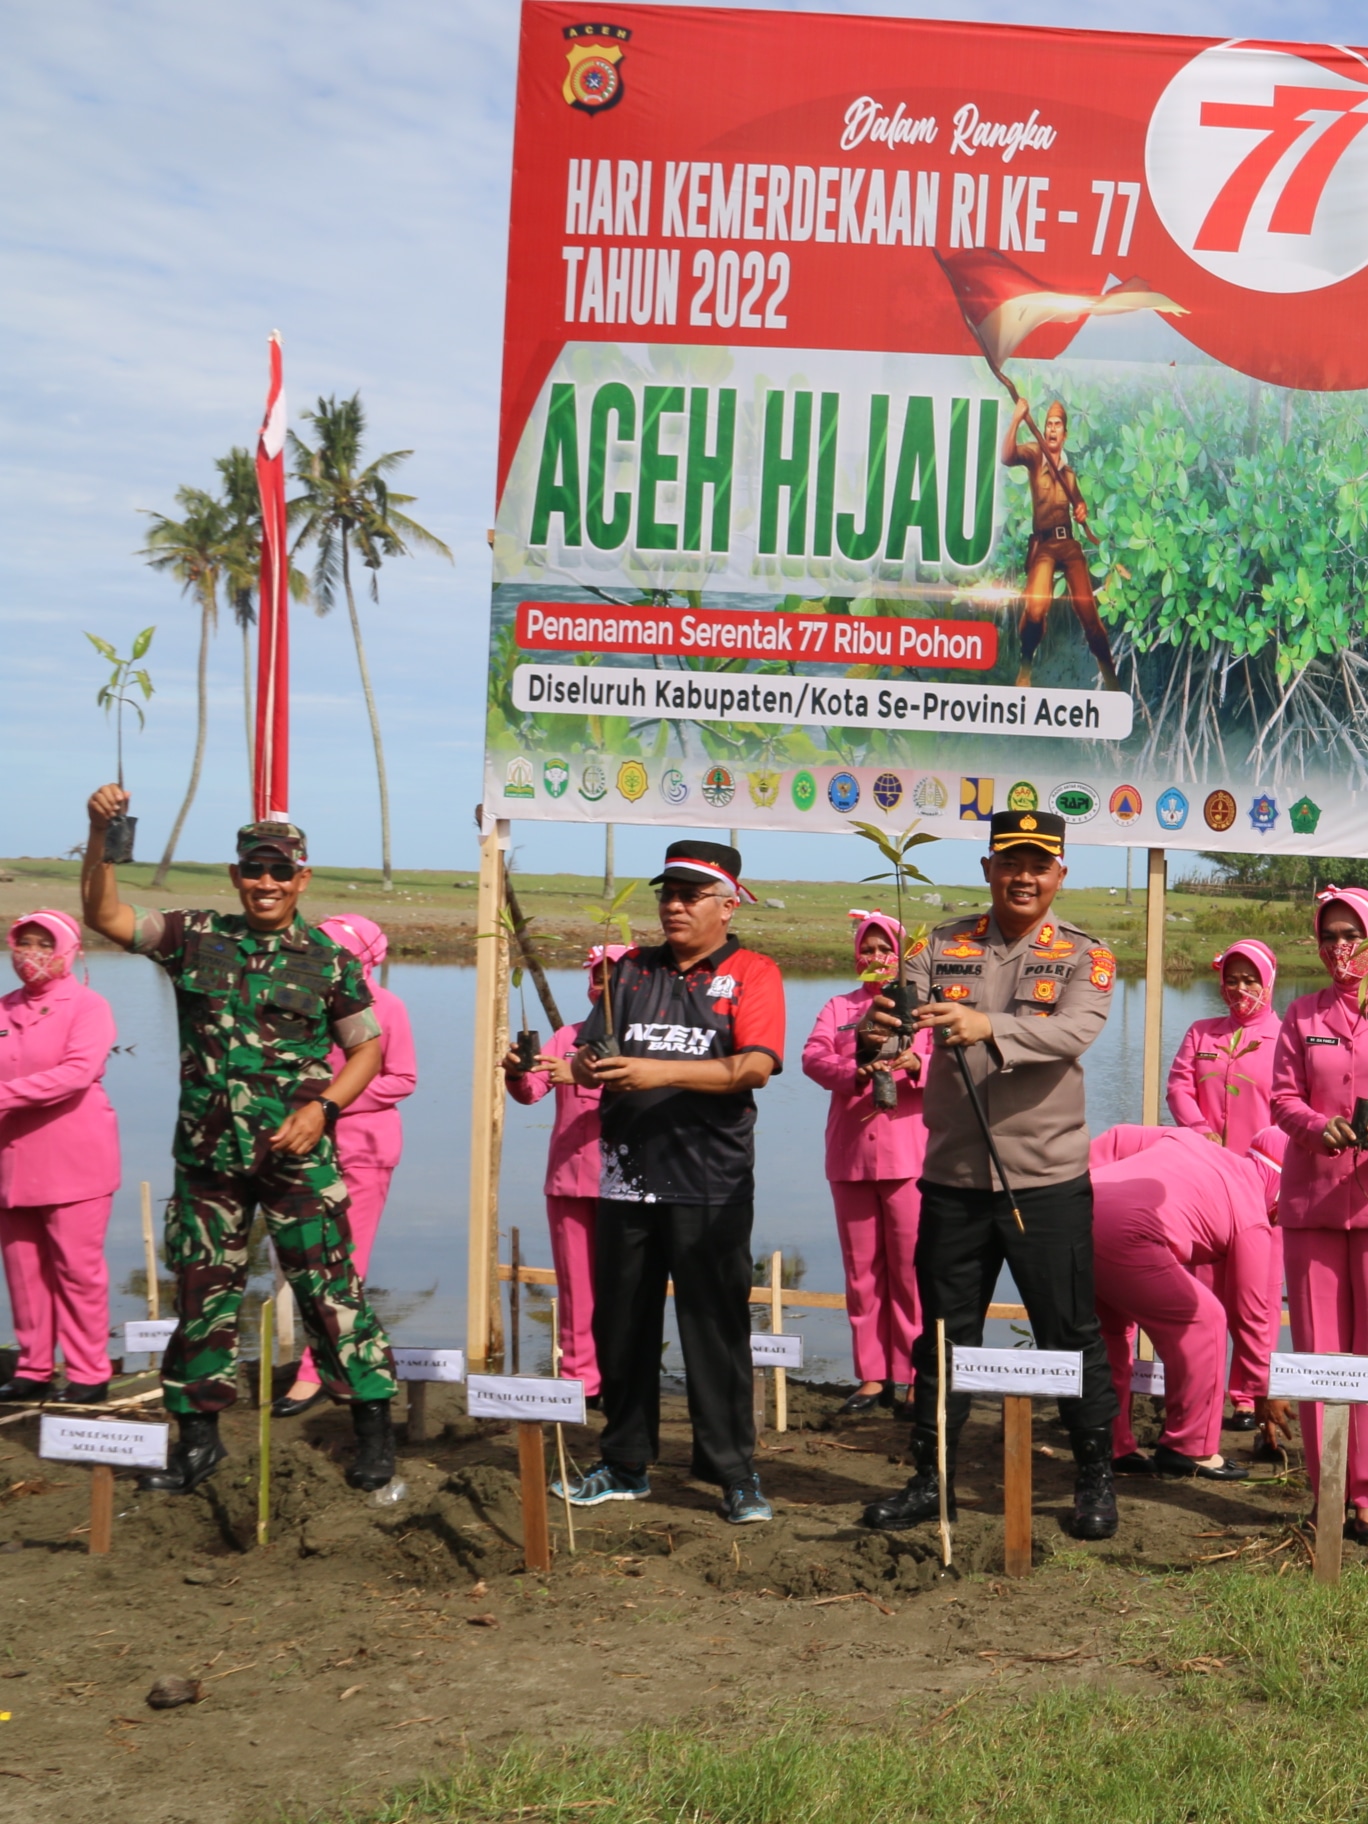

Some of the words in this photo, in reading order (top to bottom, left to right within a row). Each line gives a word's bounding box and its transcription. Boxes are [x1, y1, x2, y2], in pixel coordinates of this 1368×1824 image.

[839, 96, 938, 151] Dalam
[949, 102, 1057, 163] Rangka
[565, 158, 653, 237] HARI
[661, 161, 940, 248] KEMERDEKAAN
[950, 172, 989, 249] RI
[998, 176, 1050, 252] KE
[1091, 180, 1140, 257] 77
[562, 246, 681, 326] TAHUN
[691, 249, 791, 329] 2022
[528, 381, 738, 556] ACEH
[757, 388, 1000, 567] HIJAU
[527, 610, 673, 645] Penanaman
[679, 615, 792, 651] Serentak
[798, 622, 826, 652] 77
[834, 622, 891, 656] Ribu
[899, 626, 982, 659] Pohon
[529, 674, 646, 707] Diseluruh
[655, 680, 868, 719] Kabupaten/Kota
[877, 692, 1026, 725] Se-Provinsi
[1033, 697, 1100, 729] Aceh
[1060, 796, 1090, 810] RAPI
[624, 1023, 717, 1047] ACEH
[647, 1041, 709, 1055] BARAT
[954, 1363, 1010, 1374] KAPOLRES
[1013, 1366, 1038, 1375] ACEH
[1041, 1367, 1076, 1377] BARAT
[1303, 1368, 1361, 1379] BHAYANGKARI
[1310, 1379, 1331, 1387] ACEH
[1332, 1379, 1360, 1389] BARAT
